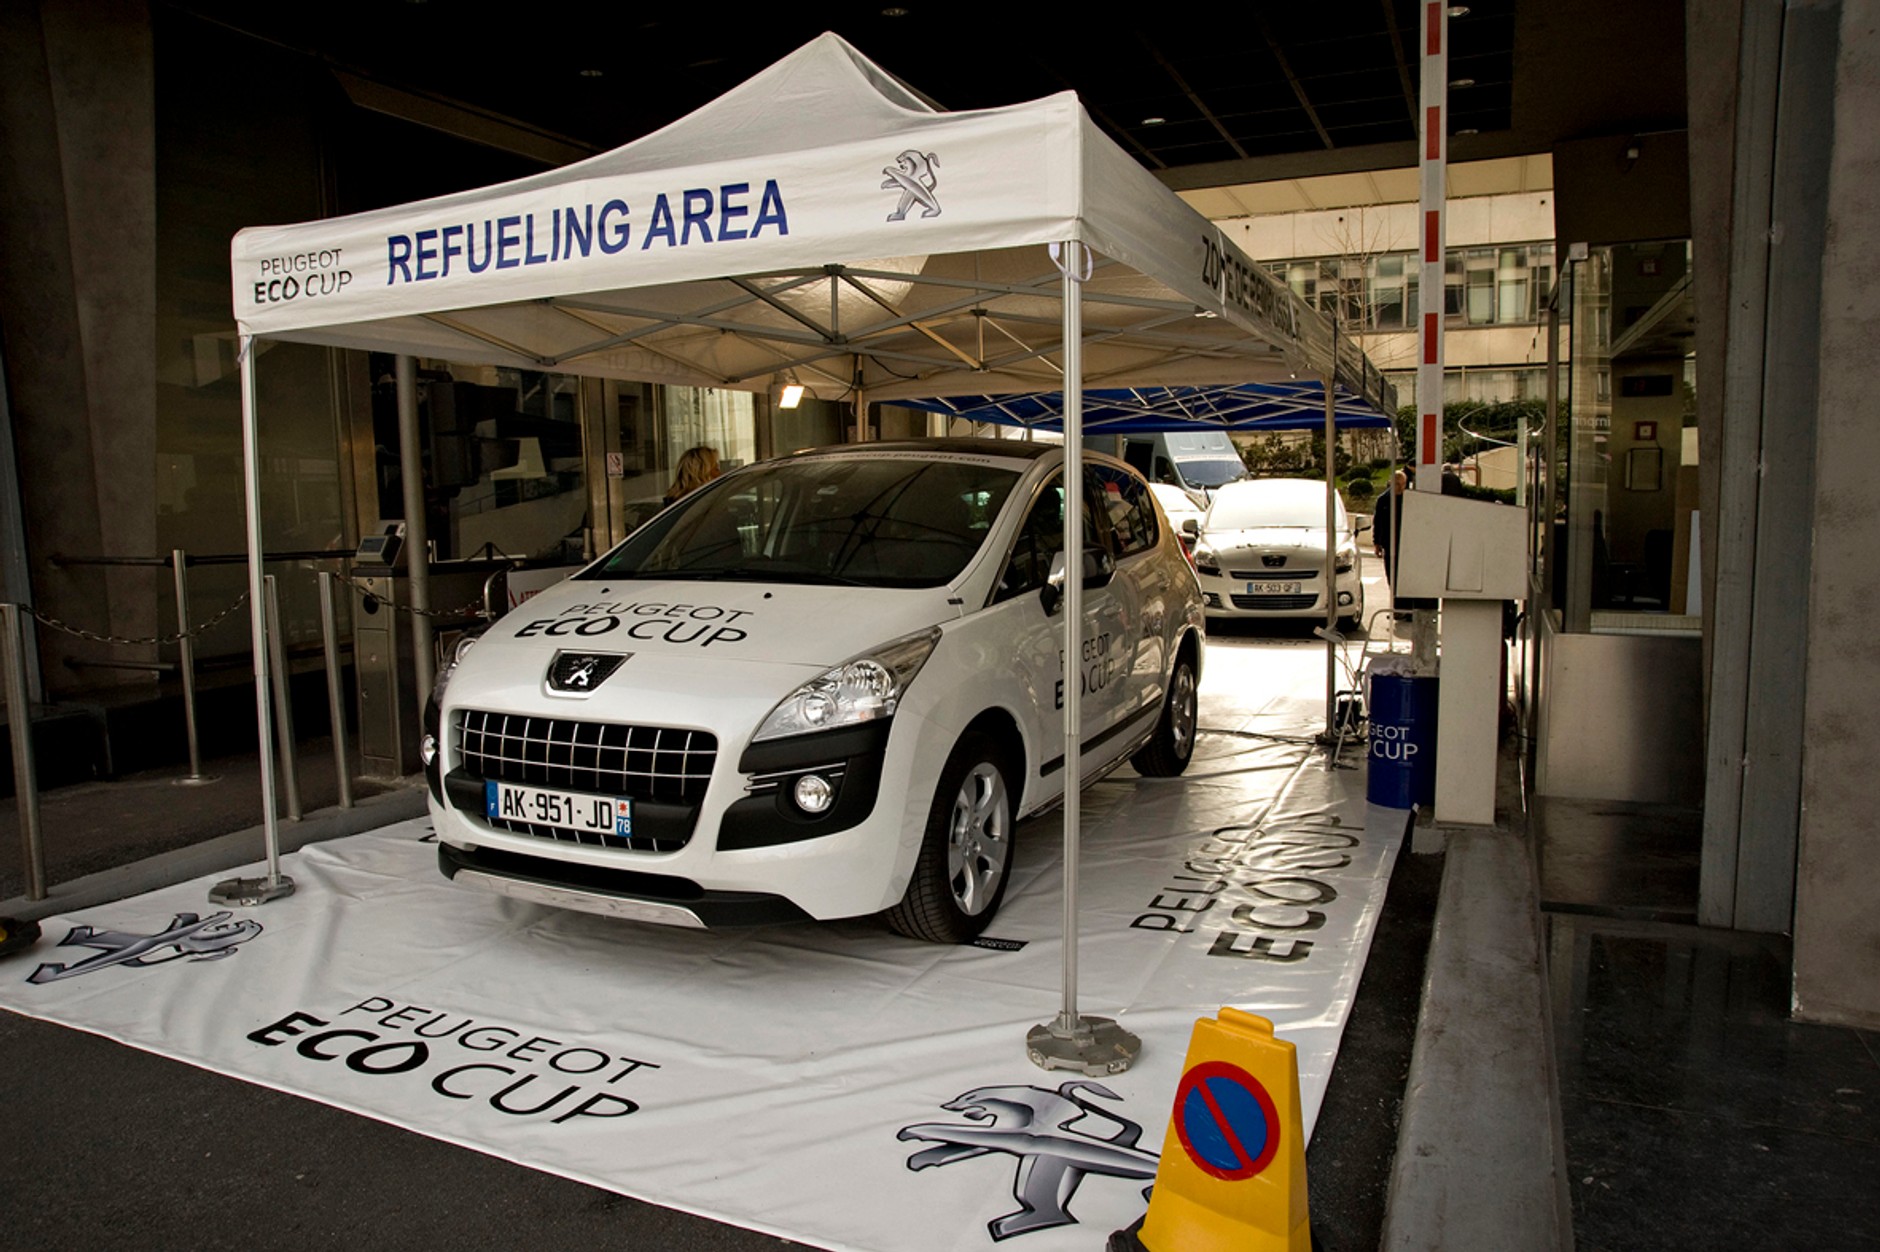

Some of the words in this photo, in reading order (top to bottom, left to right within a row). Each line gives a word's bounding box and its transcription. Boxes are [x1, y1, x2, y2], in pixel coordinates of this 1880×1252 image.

[387, 198, 631, 285] REFUELING
[642, 179, 789, 251] AREA
[260, 248, 343, 276] PEUGEOT
[254, 275, 300, 304] ECO
[304, 270, 353, 298] CUP
[559, 602, 754, 623] PEUGEOT
[514, 615, 621, 638] ECO
[628, 619, 748, 647] CUP
[1059, 632, 1110, 672] PGEOT
[1088, 658, 1116, 694] CUP
[1373, 739, 1419, 760] CUP
[617, 818, 631, 834] 78
[1206, 876, 1339, 964] ECO
[339, 996, 661, 1084] PEUGEOT
[246, 1011, 430, 1075] ECO
[431, 1063, 640, 1124] CUP
